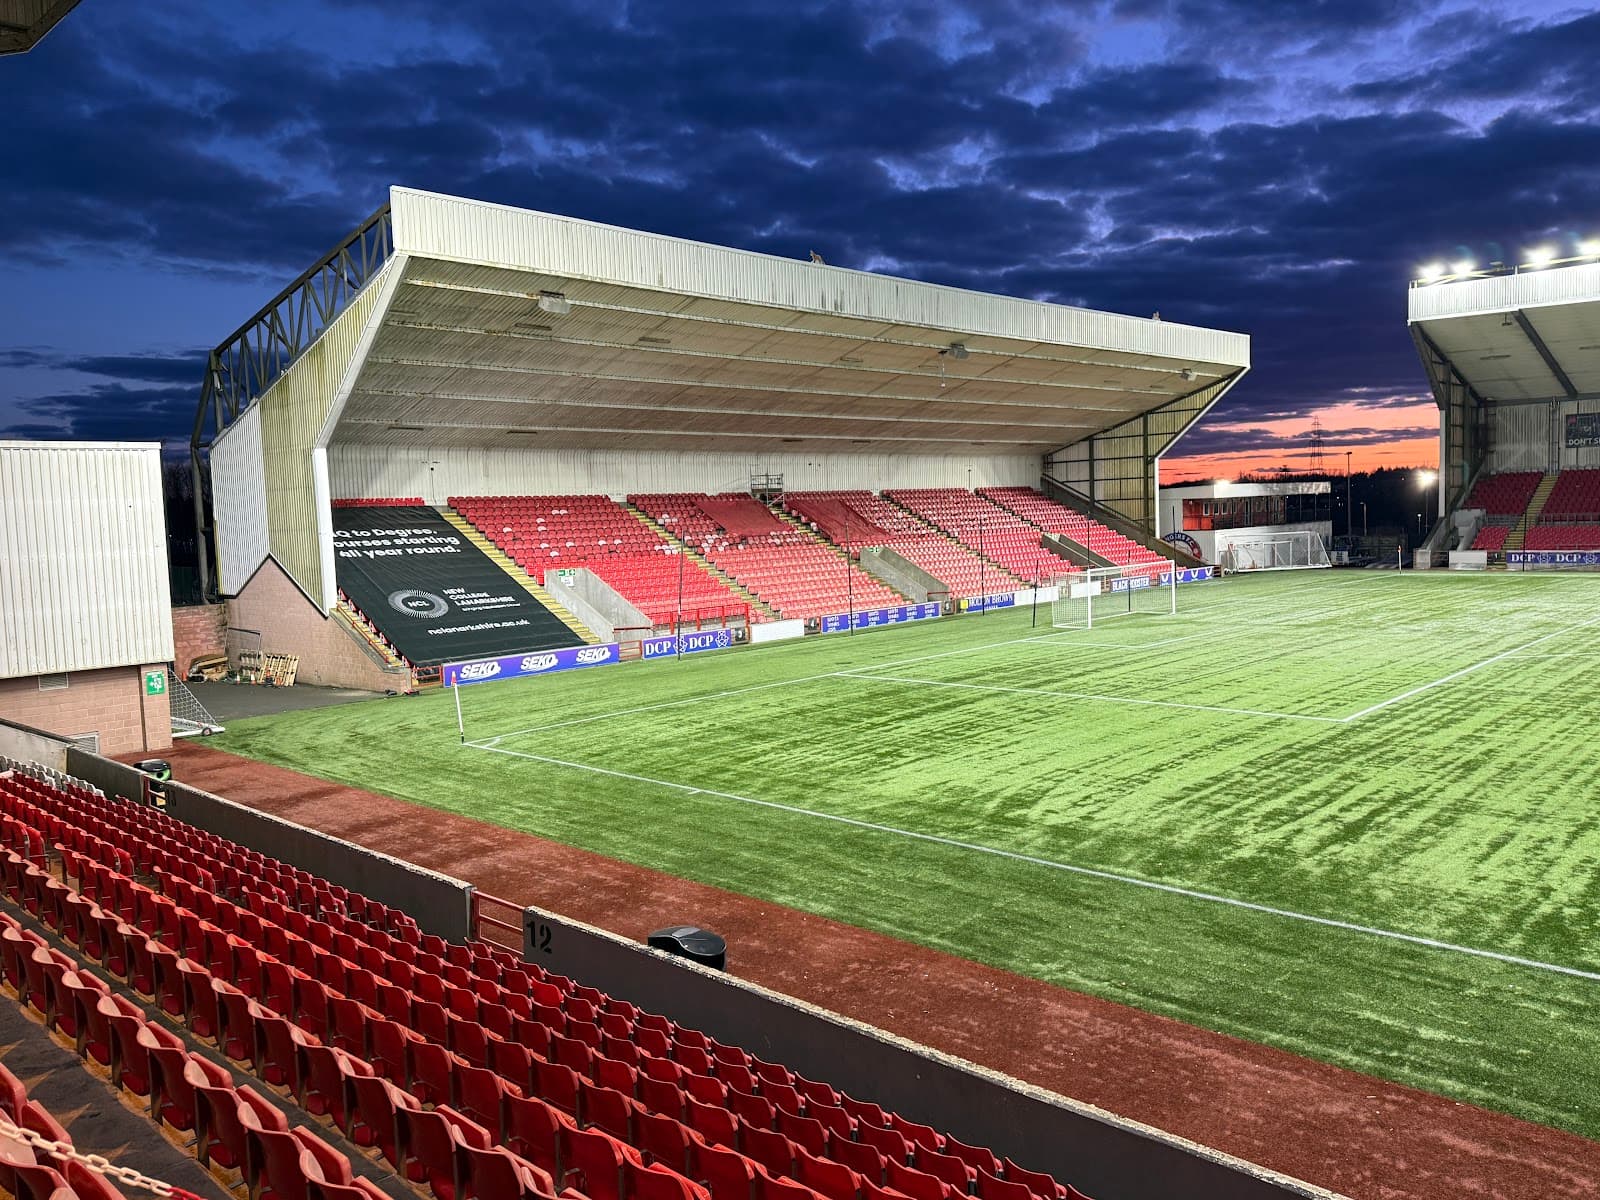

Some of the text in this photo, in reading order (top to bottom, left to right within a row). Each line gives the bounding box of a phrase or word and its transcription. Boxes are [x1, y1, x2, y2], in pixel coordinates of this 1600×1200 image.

[352, 529, 371, 537] to
[371, 528, 438, 538] Degree.
[334, 536, 460, 548] ourses starting
[339, 545, 461, 559] all year round.
[1511, 553, 1581, 562] DCP DCP
[408, 600, 430, 608] NCL
[645, 634, 714, 656] DCP DCP
[460, 647, 612, 680] SEKO SEKO SEKO
[526, 920, 553, 954] 12
